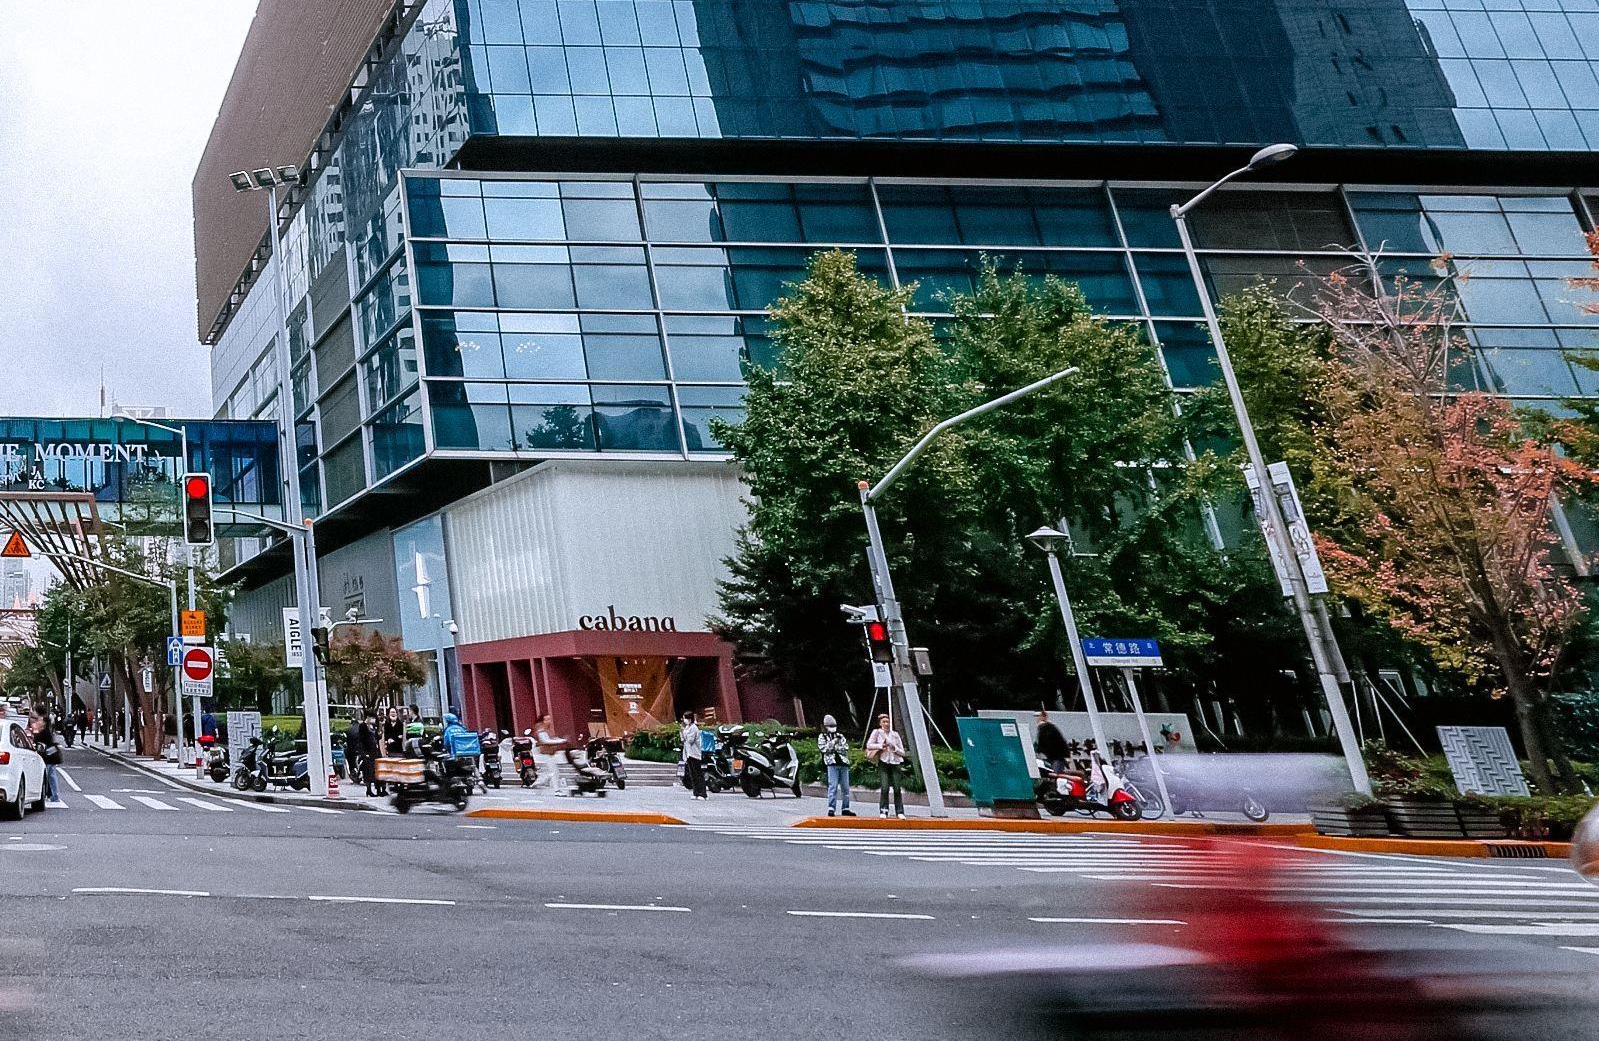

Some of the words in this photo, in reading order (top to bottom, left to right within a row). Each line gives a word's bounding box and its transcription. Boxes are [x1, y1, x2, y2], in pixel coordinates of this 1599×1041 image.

[34, 443, 149, 463] MOMENT
[578, 604, 677, 632] cabana
[289, 618, 302, 651] AIGLE
[1102, 641, 1141, 655] 常德路
